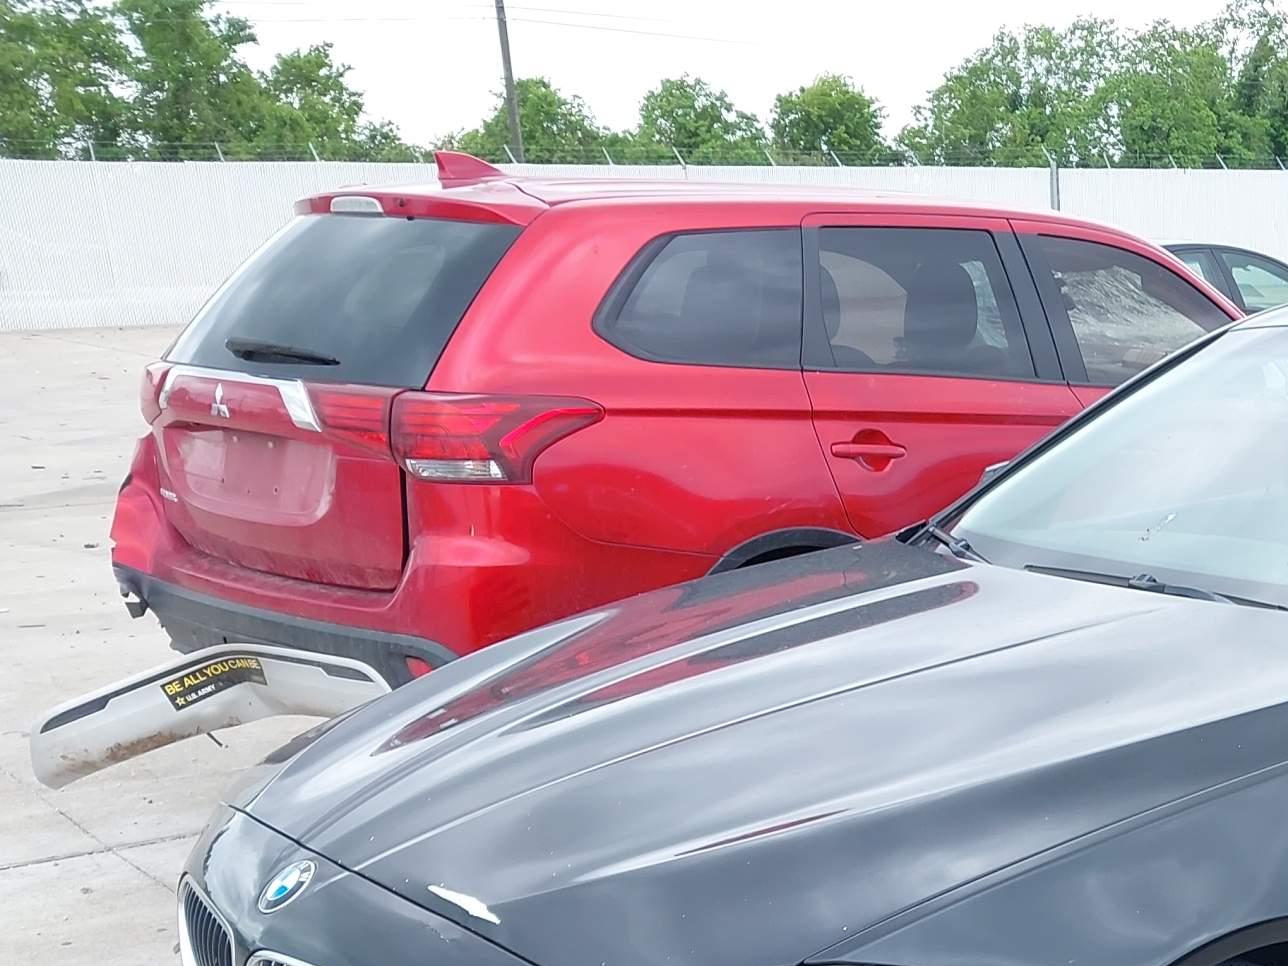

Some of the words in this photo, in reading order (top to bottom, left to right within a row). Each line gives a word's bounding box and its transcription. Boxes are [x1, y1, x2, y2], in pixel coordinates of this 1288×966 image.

[164, 680, 184, 696] BE
[183, 671, 207, 688] ALL
[203, 661, 229, 678] YOU
[228, 659, 249, 669] CAN
[197, 683, 217, 698] ARMY
